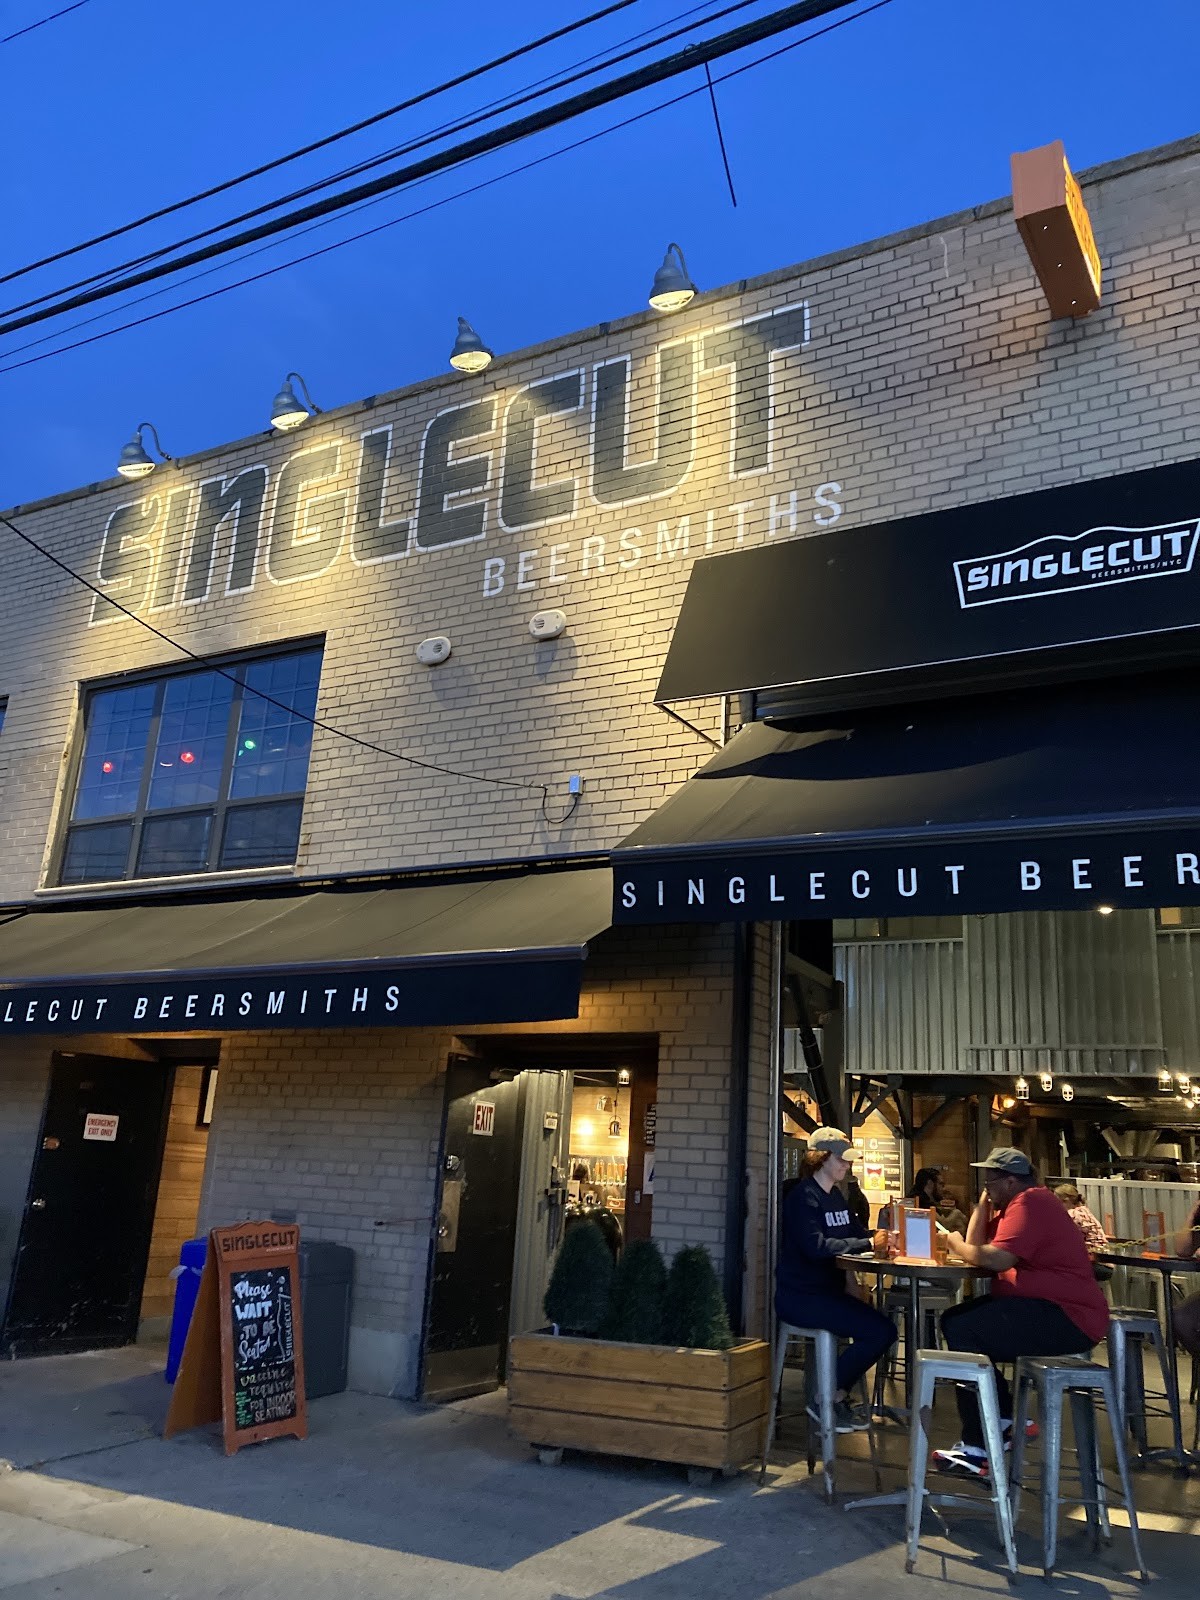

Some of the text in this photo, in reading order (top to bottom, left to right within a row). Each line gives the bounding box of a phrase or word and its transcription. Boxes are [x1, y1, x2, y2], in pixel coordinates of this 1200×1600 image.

[482, 481, 845, 598] BEERSMITHS
[967, 530, 1190, 592] SINGLECUT
[622, 852, 1200, 908] SINGLECUT BEER
[4, 985, 400, 1022] LECUT BEERSMITHS
[88, 1119, 116, 1127] EMERGENCY
[475, 1105, 493, 1131] EXIT
[101, 1128, 113, 1136] ONLY
[222, 1231, 295, 1252] SINGLECUT
[234, 1280, 273, 1300] Please
[234, 1300, 273, 1321] WAIT
[242, 1319, 277, 1340] TO BE
[239, 1335, 271, 1364] Seated
[255, 1405, 292, 1423] SEATING
